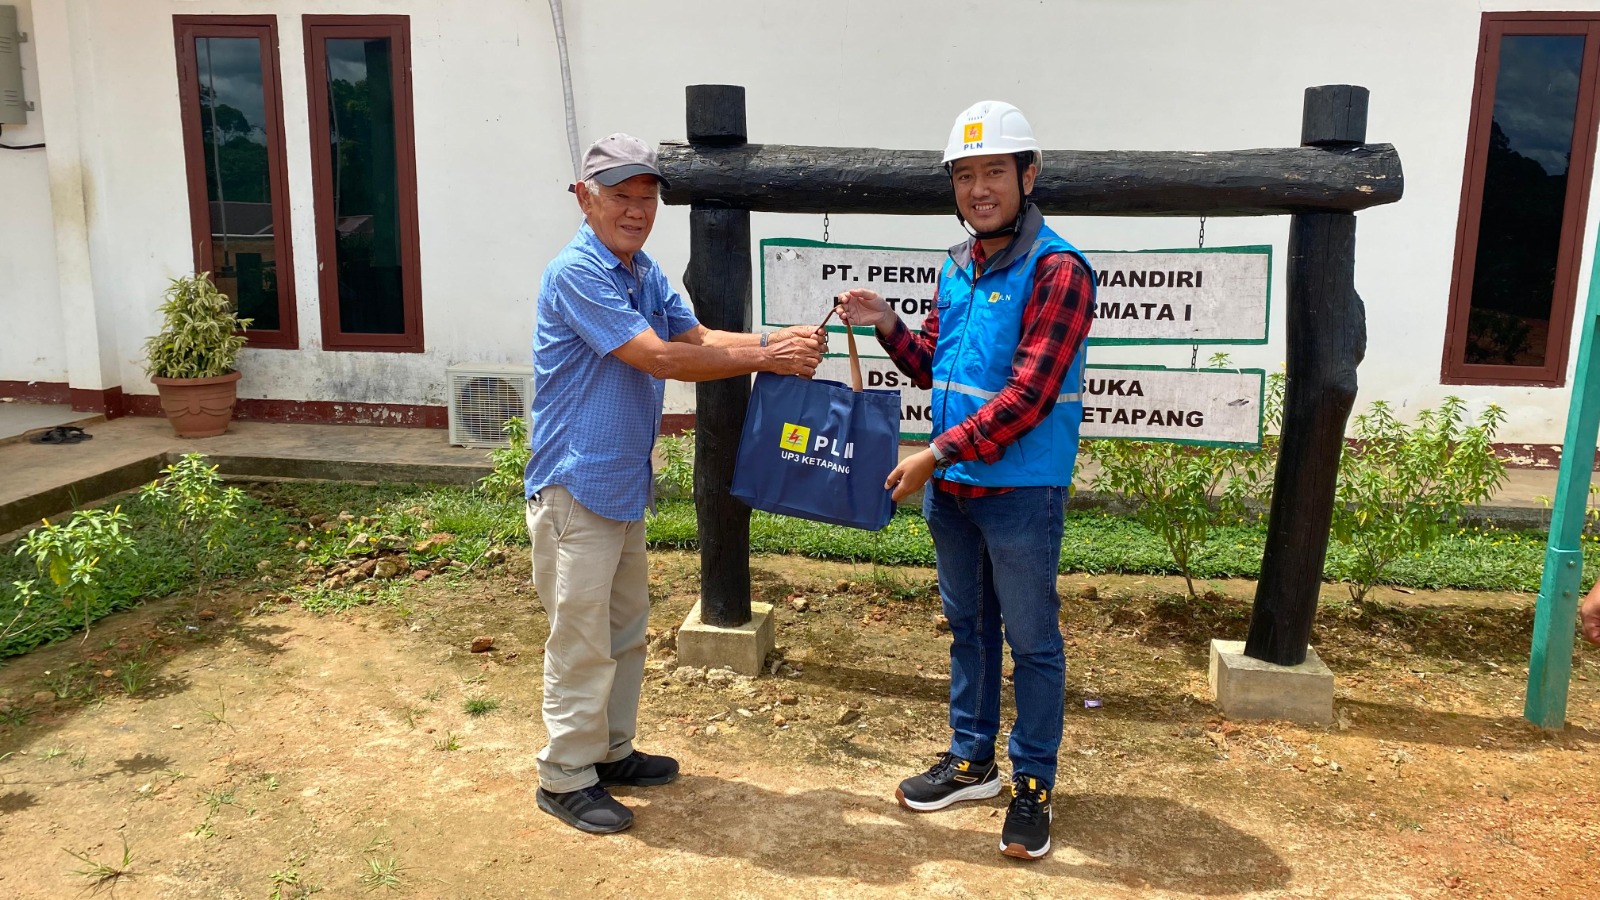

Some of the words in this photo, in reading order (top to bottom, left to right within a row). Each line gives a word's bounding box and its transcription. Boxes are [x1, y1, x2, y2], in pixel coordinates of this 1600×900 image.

[964, 142, 983, 150] PLN
[822, 264, 859, 282] PT.
[1092, 270, 1202, 288] MANDIRI
[1185, 304, 1192, 322] I
[868, 371, 918, 388] DS-
[1082, 379, 1145, 397] UKA
[1081, 406, 1204, 427] ETAPANG
[781, 450, 800, 463] UP3
[802, 455, 850, 475] KETAPANG
